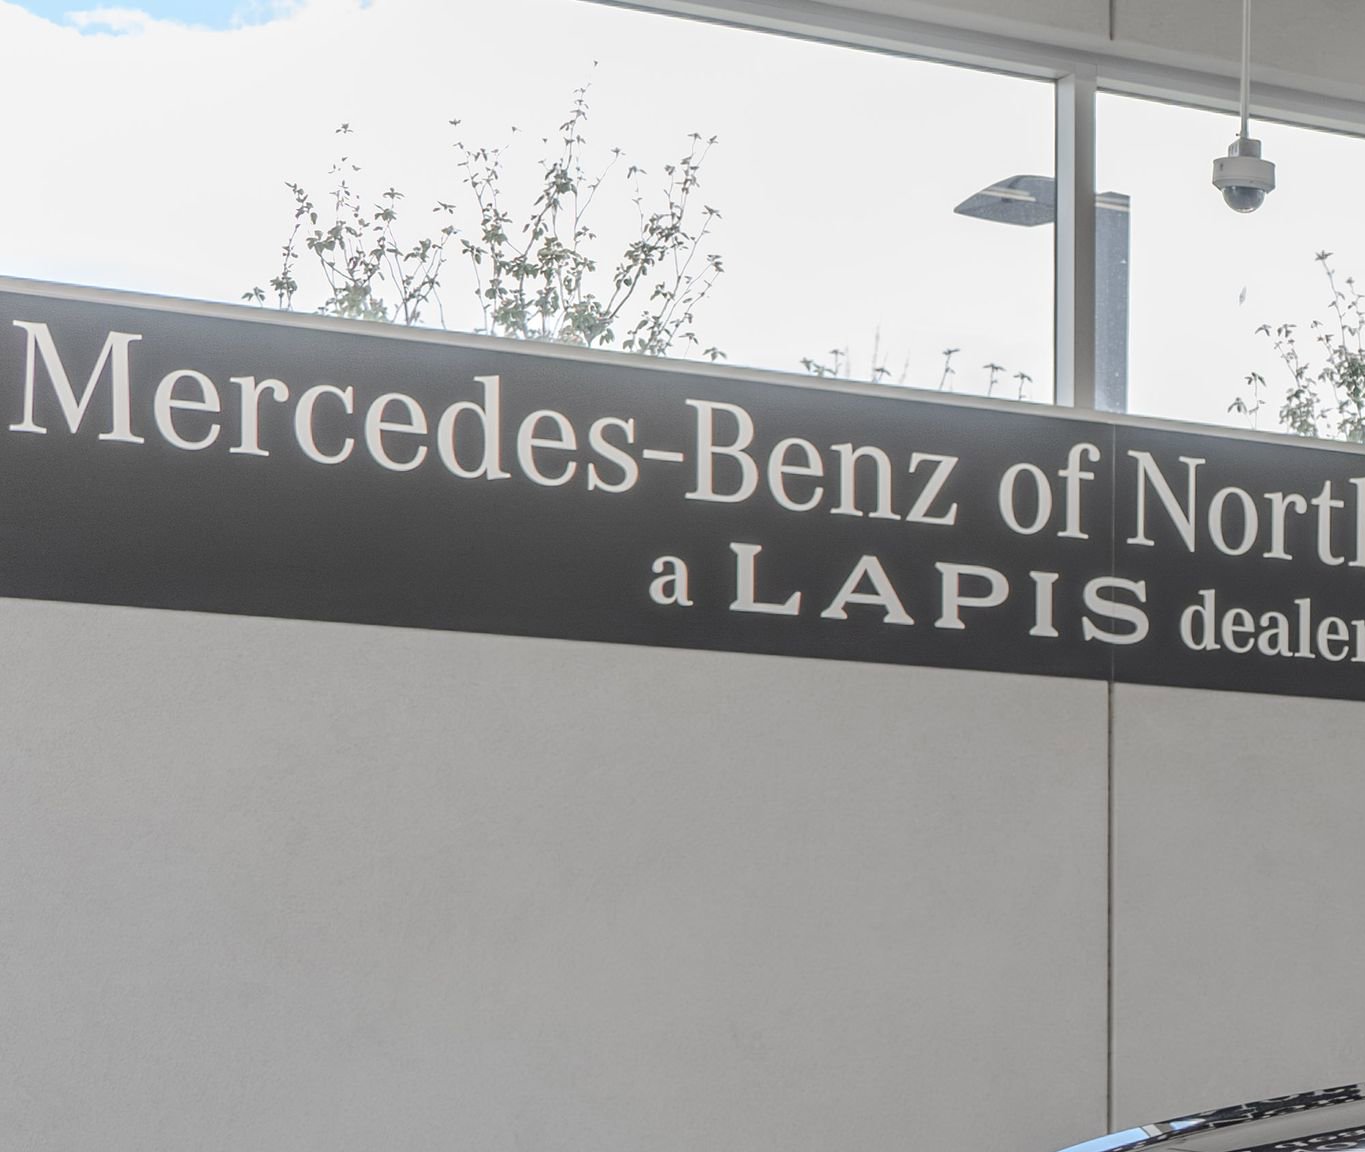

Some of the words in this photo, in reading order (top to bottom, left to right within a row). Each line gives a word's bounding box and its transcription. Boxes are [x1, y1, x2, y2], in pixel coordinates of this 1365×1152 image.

[8, 316, 960, 527] Mercedes-Benz
[998, 442, 1101, 541] of
[649, 555, 695, 607] a
[729, 542, 1149, 645] LAPIS
